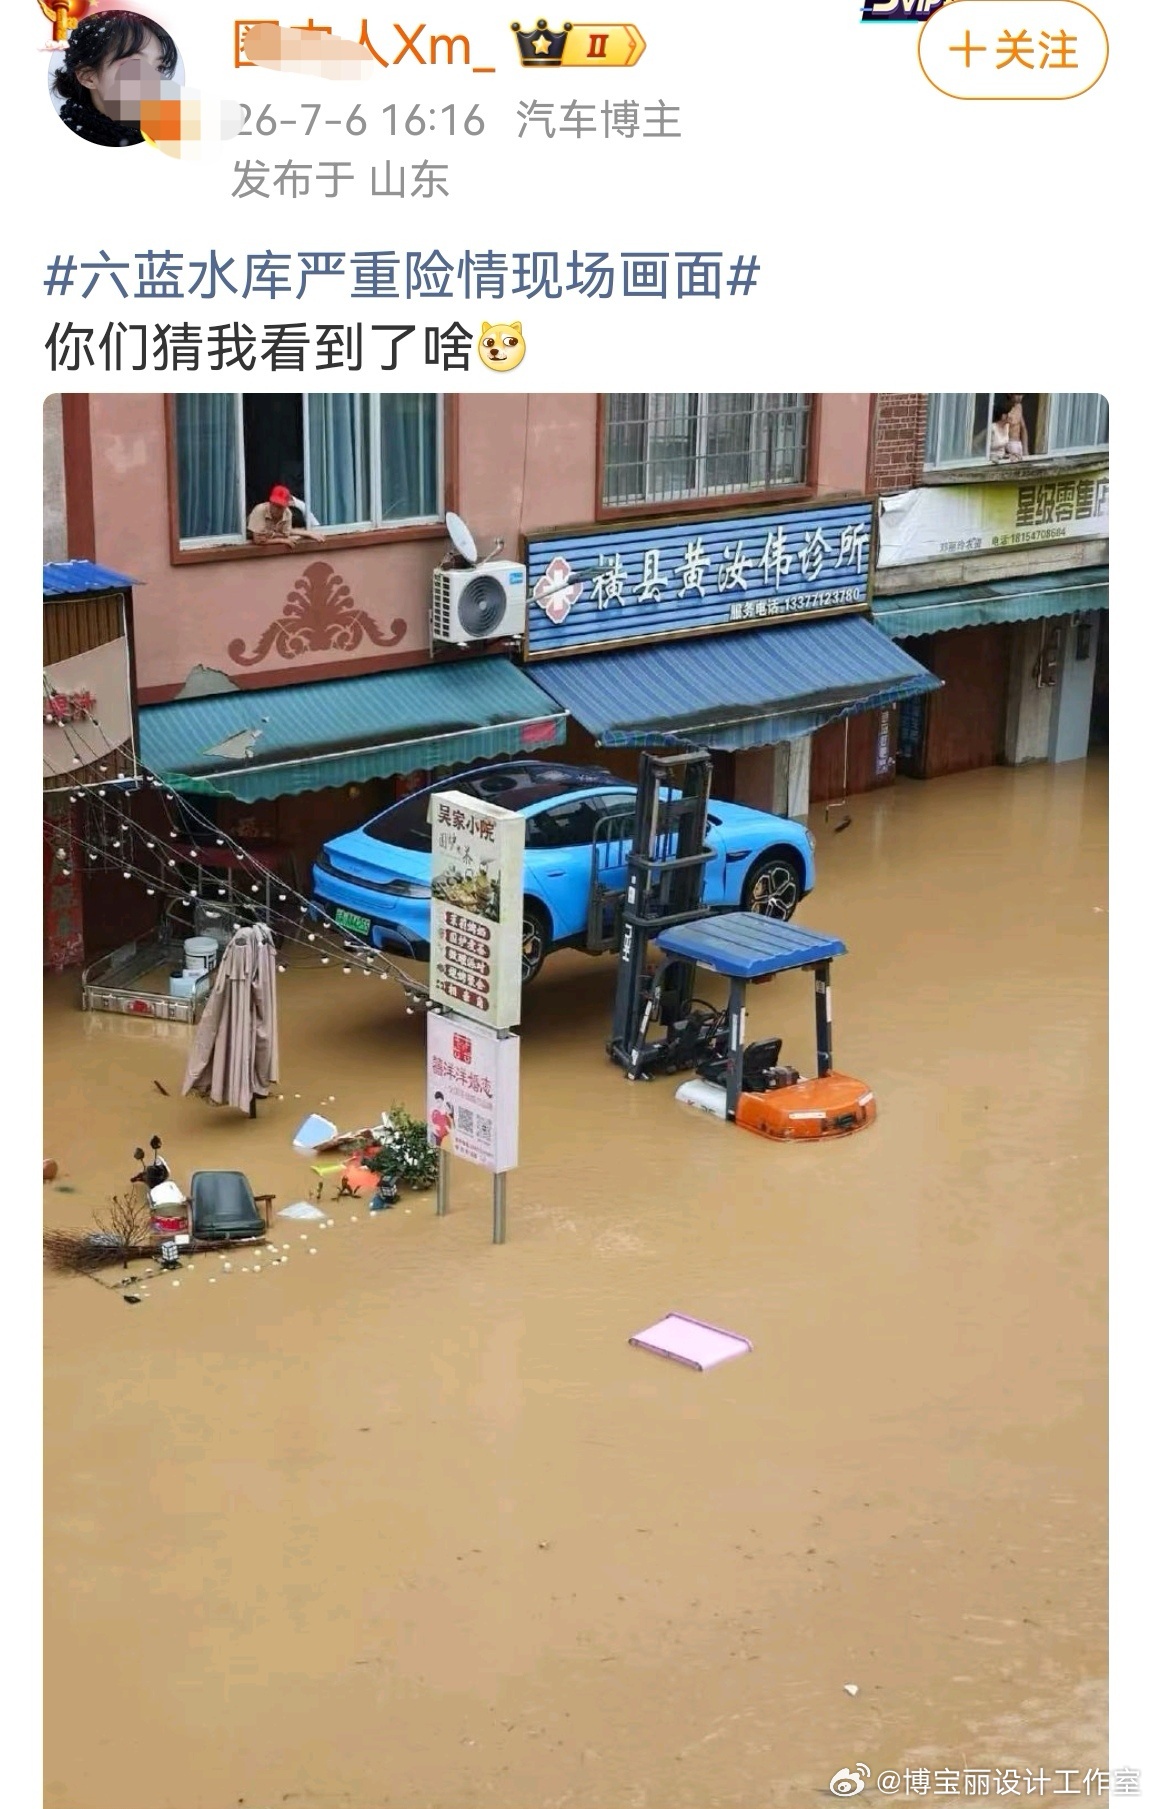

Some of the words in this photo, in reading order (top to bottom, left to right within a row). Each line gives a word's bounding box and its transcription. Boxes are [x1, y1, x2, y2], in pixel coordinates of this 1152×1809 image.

[590, 522, 869, 610] 横县黄汝伟诊所
[438, 804, 496, 843] 吴家小院
